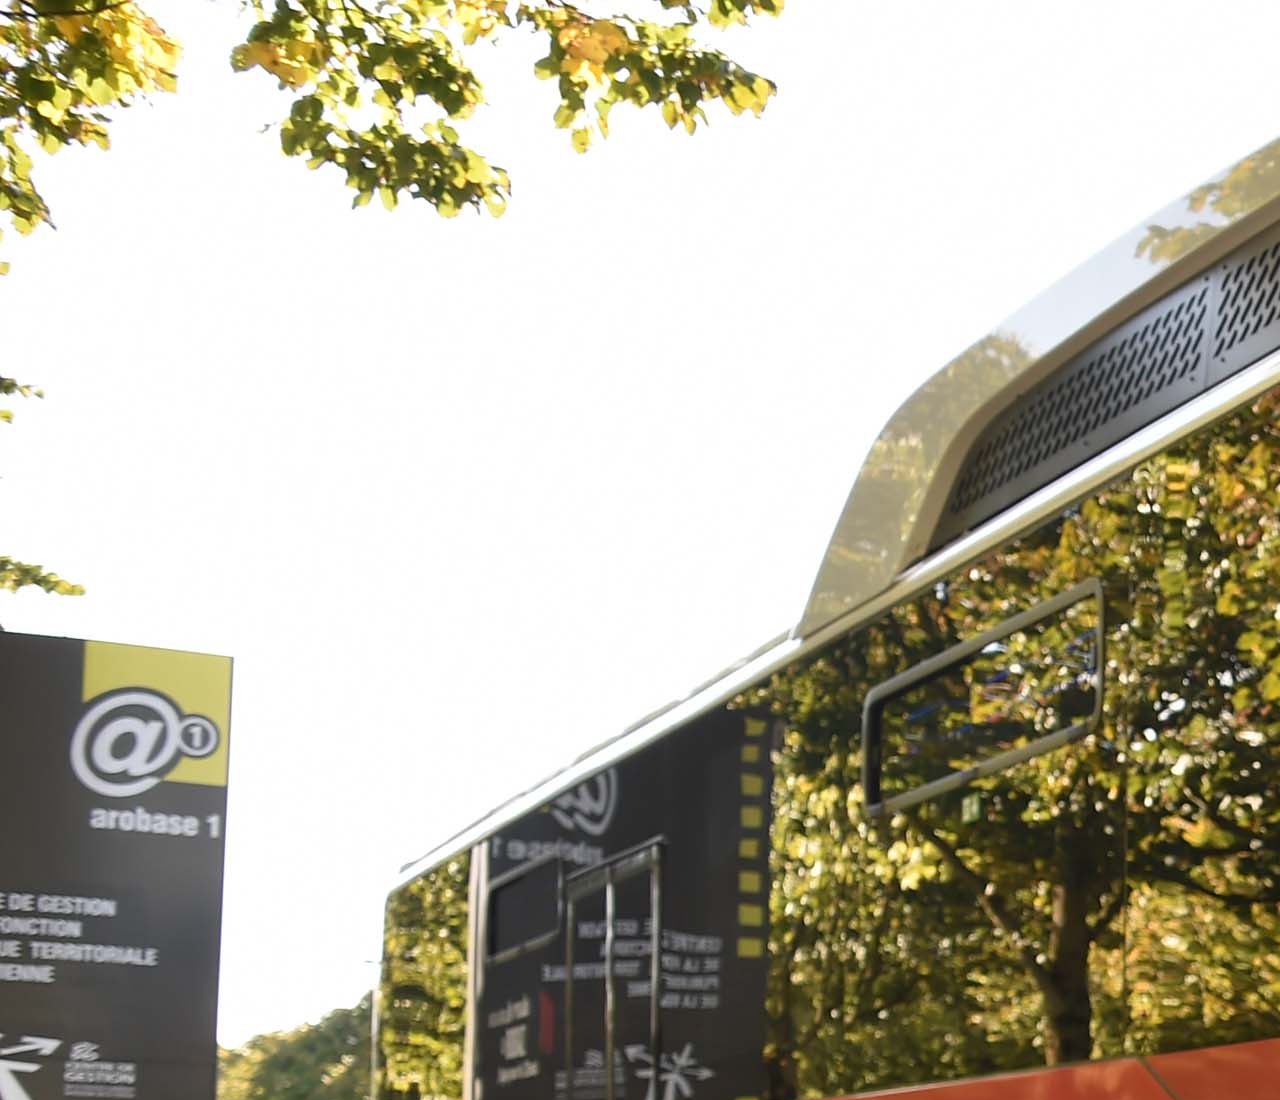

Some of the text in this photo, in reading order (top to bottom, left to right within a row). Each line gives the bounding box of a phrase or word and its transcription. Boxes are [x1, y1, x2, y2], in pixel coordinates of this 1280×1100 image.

[90, 807, 221, 838] arobase 1
[8, 894, 35, 911] DE
[38, 895, 117, 917] GESTION
[30, 941, 159, 966] TERRITORIALE
